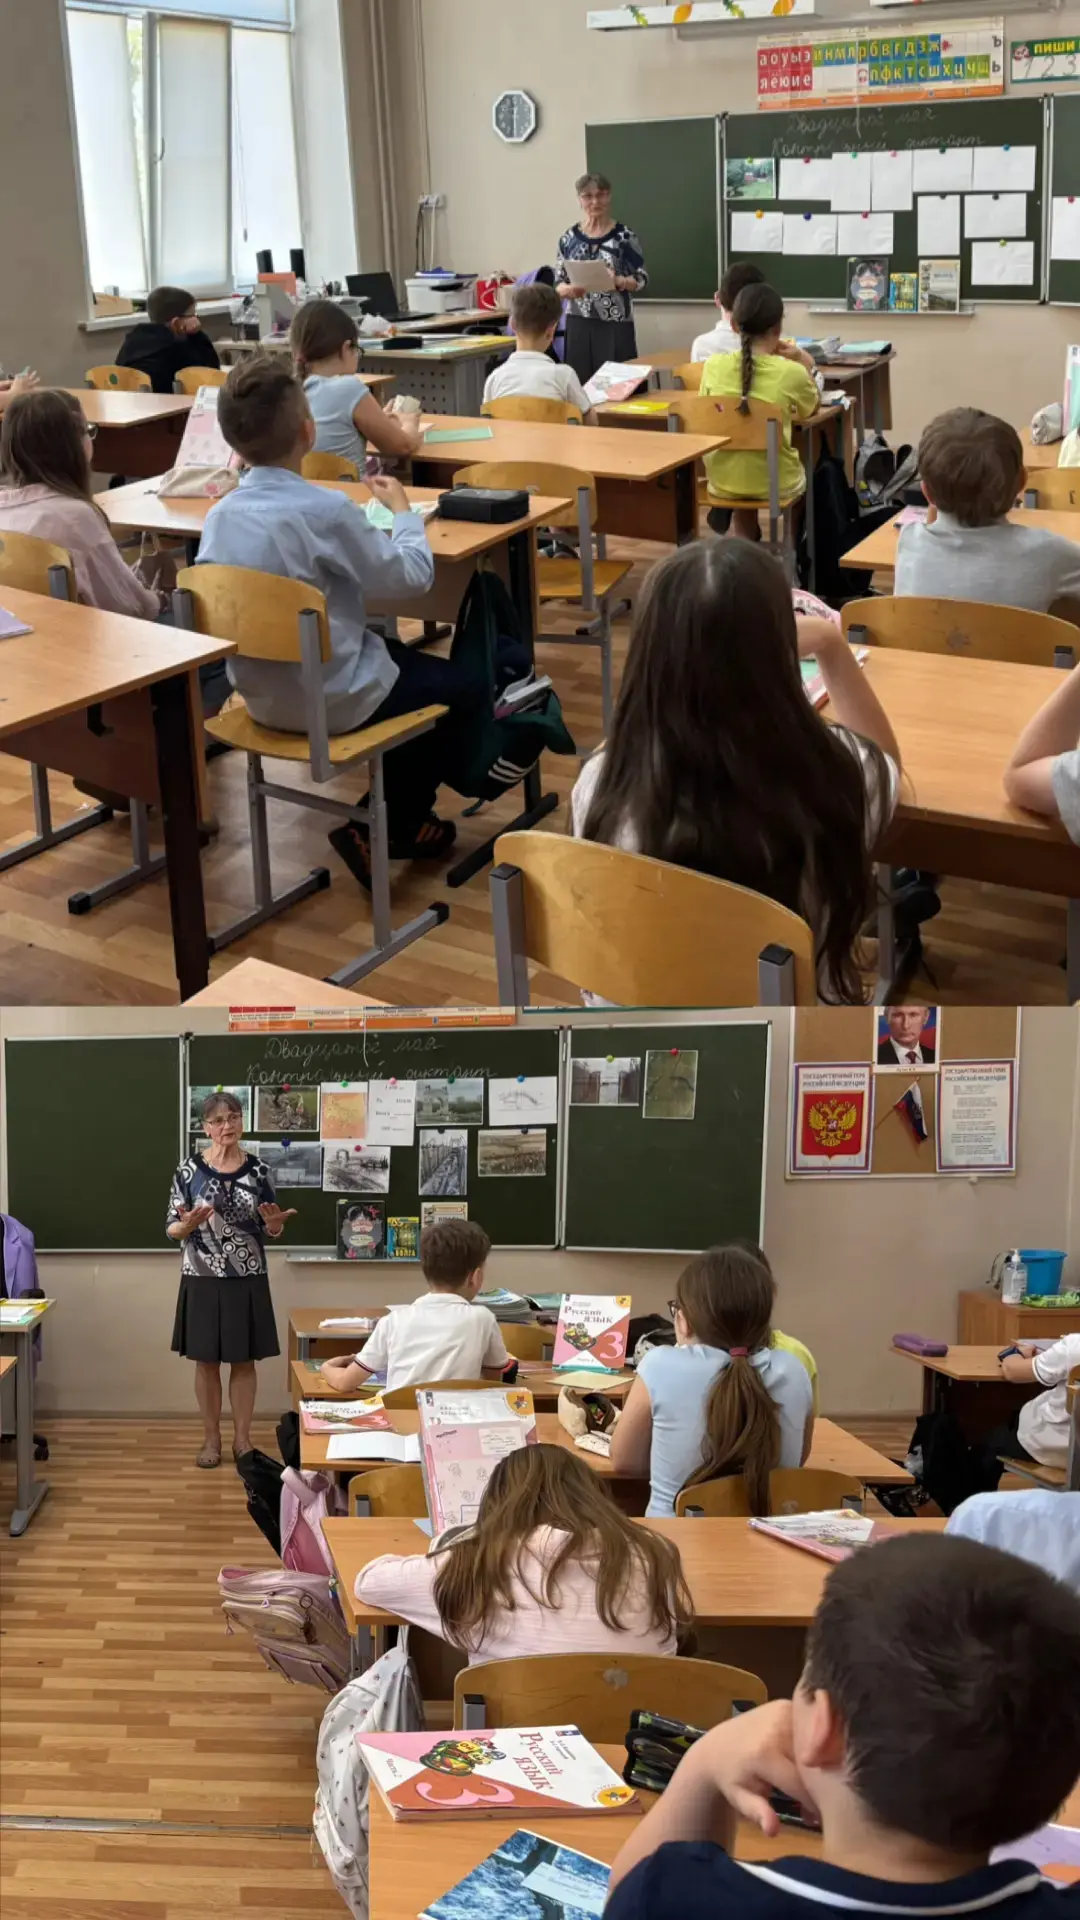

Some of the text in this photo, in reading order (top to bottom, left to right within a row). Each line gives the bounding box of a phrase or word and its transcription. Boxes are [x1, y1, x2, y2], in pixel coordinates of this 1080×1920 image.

[1042, 56, 1055, 79] 2
[1063, 55, 1077, 75] 3
[600, 1331, 624, 1359] 3
[519, 1732, 563, 1775] Русский
[415, 1780, 515, 1806] 3
